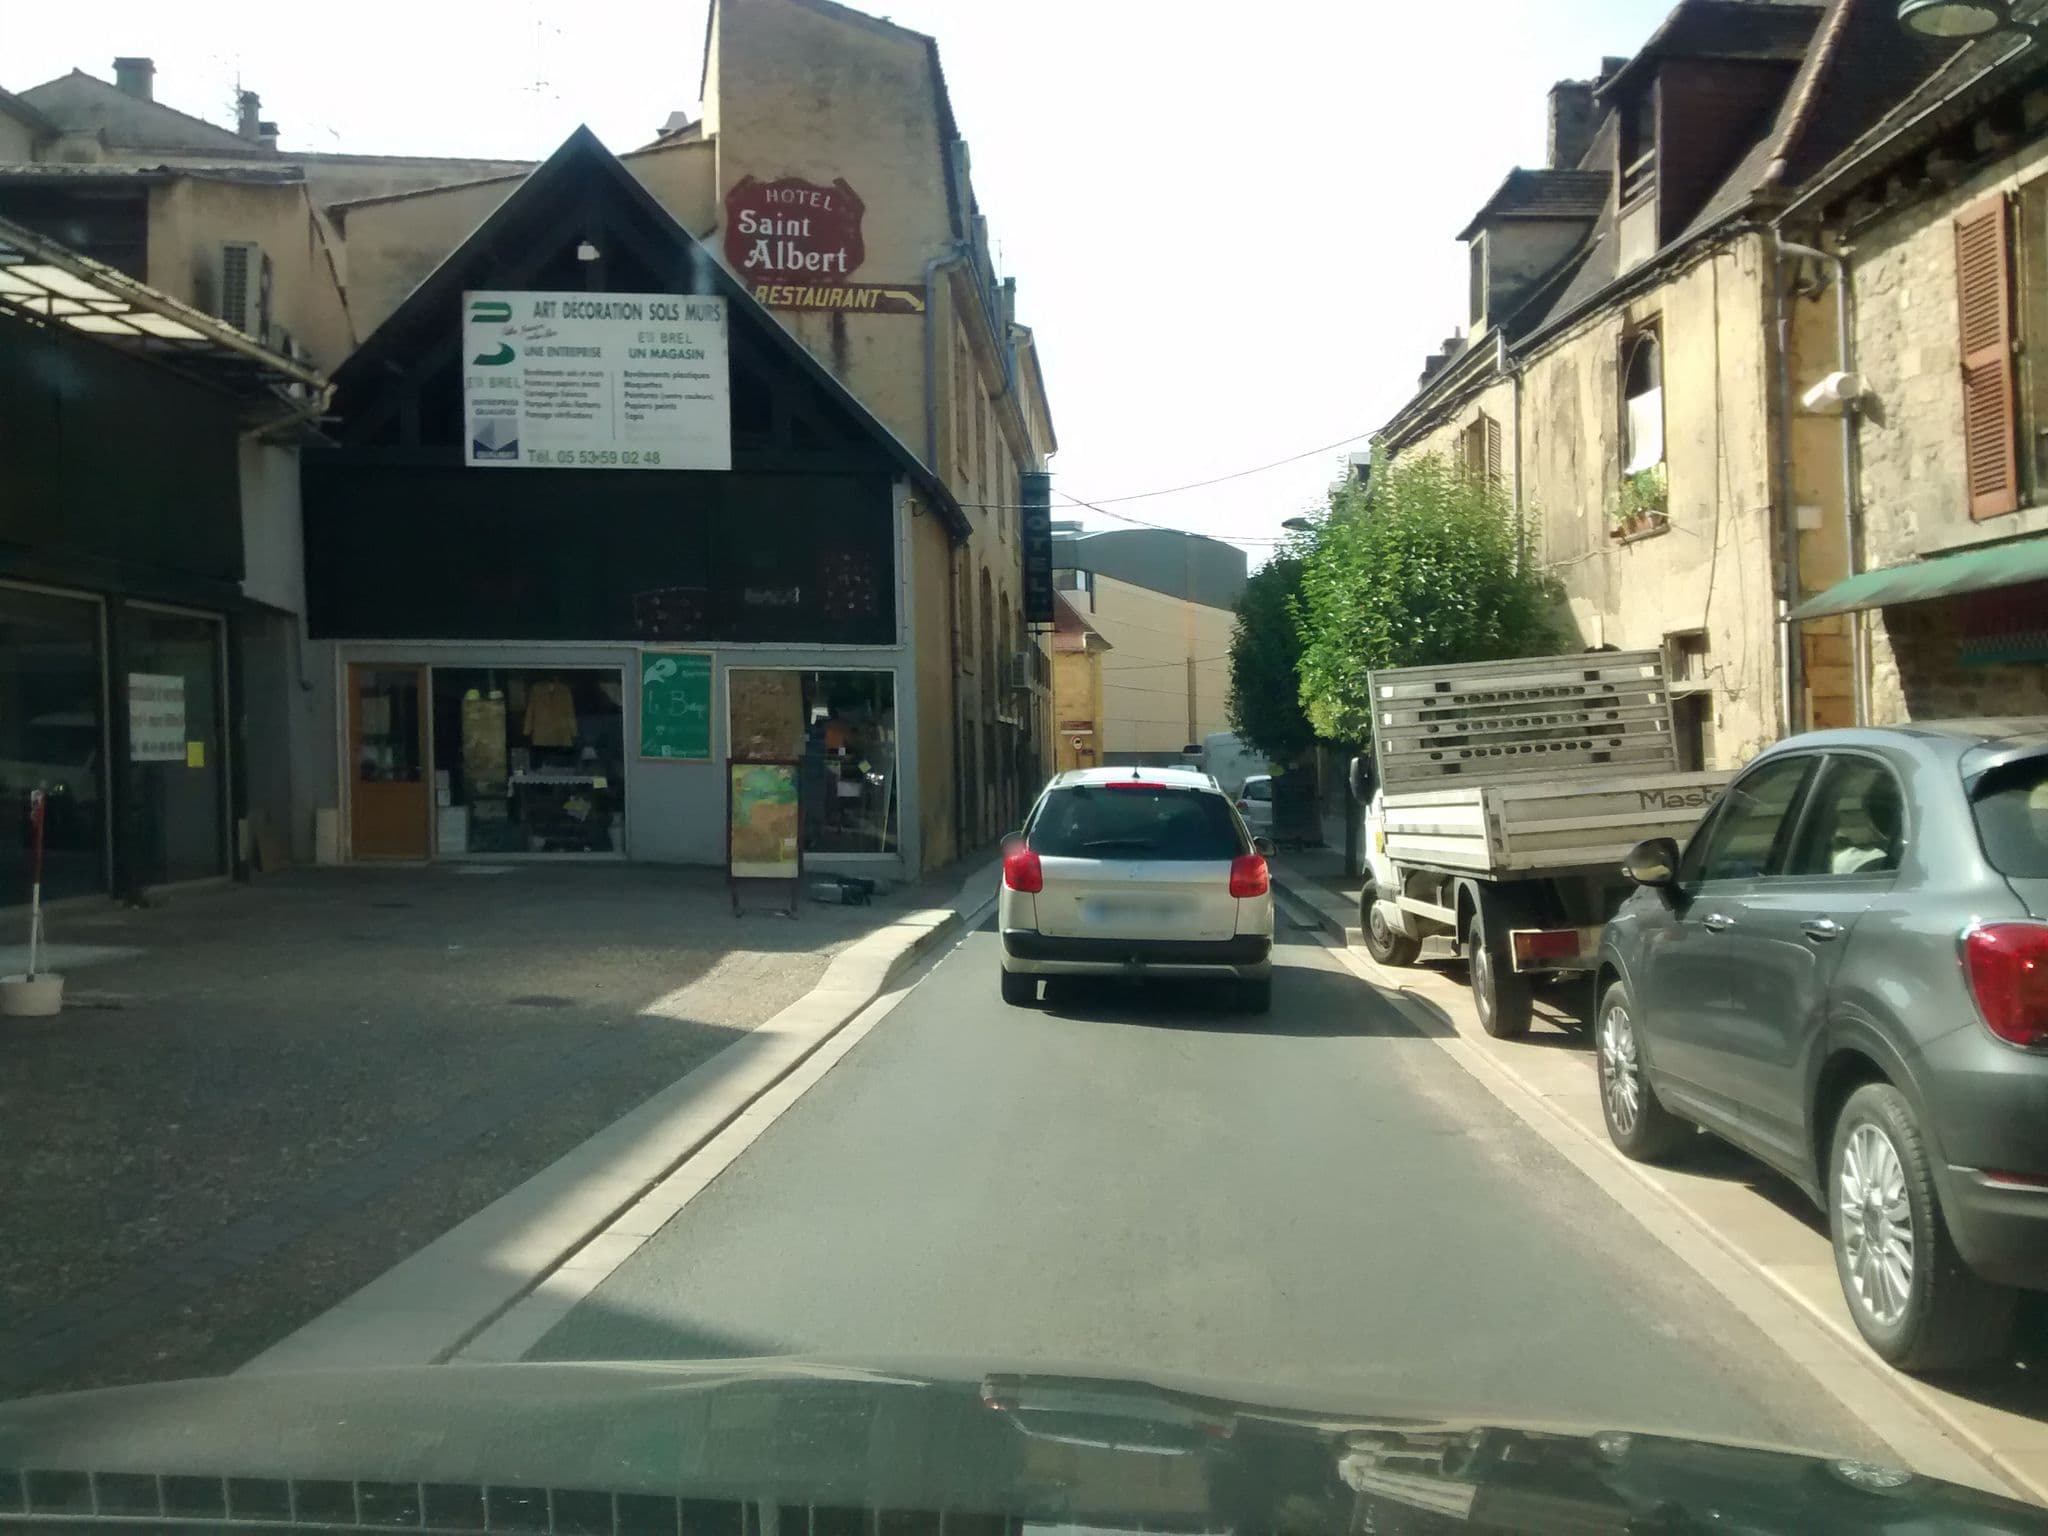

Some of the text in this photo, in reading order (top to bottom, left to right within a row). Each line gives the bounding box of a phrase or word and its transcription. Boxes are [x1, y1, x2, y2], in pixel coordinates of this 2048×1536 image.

[765, 188, 833, 212] HOTEL
[738, 209, 811, 237] Saint
[743, 239, 848, 273] Albert
[755, 285, 883, 309] RESTAURANT
[533, 301, 557, 319] ART
[649, 302, 680, 321] SOLS
[660, 332, 693, 345] BREL
[628, 347, 705, 360] UN MAGASIN
[557, 450, 575, 464] 05
[622, 451, 639, 465] 02
[643, 451, 661, 465] 48
